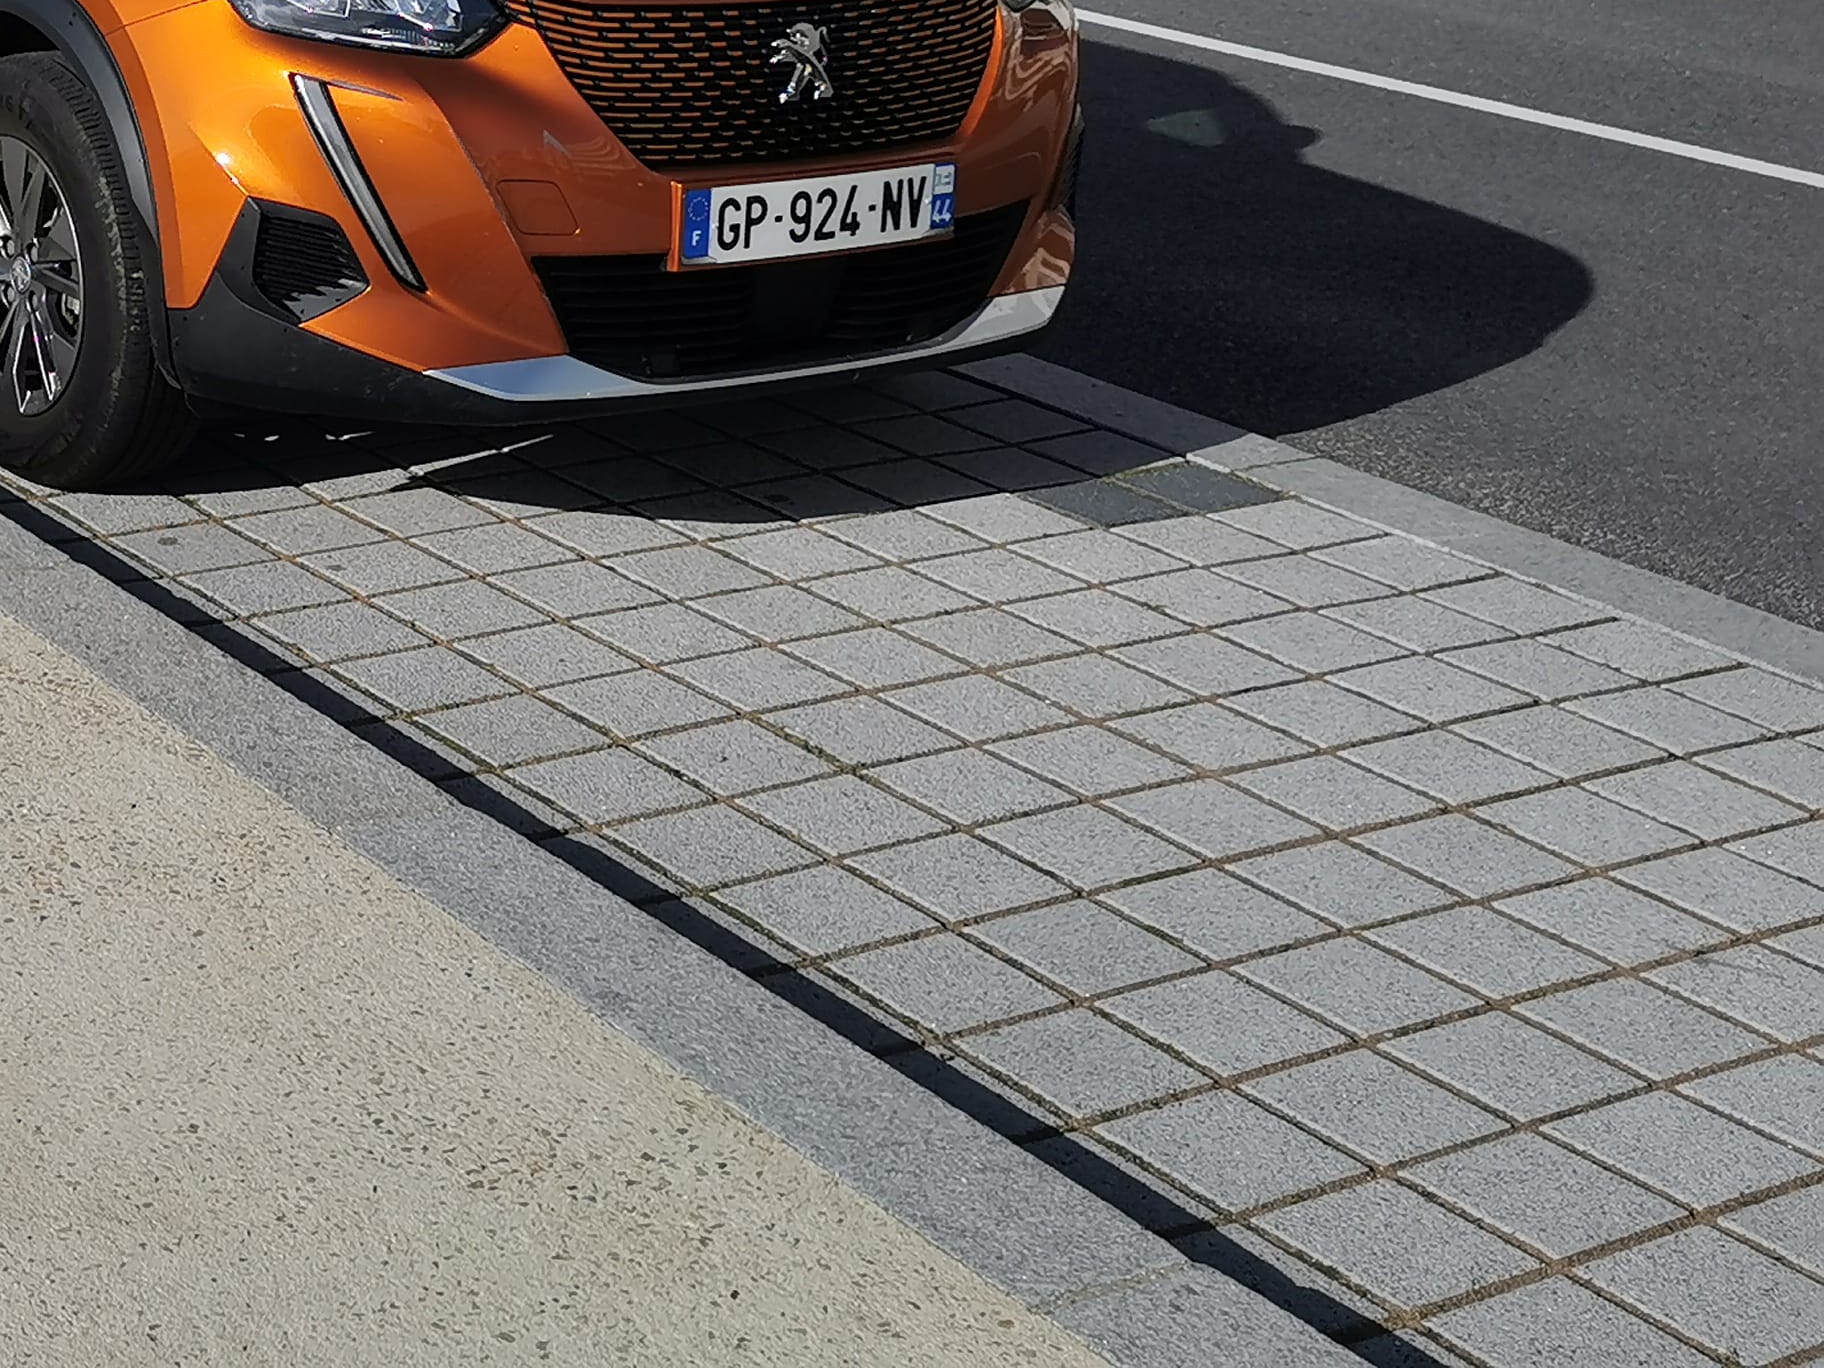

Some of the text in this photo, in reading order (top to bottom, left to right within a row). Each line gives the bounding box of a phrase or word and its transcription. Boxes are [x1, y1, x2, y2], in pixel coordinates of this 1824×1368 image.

[691, 175, 953, 251] F GP-924-NV 44
